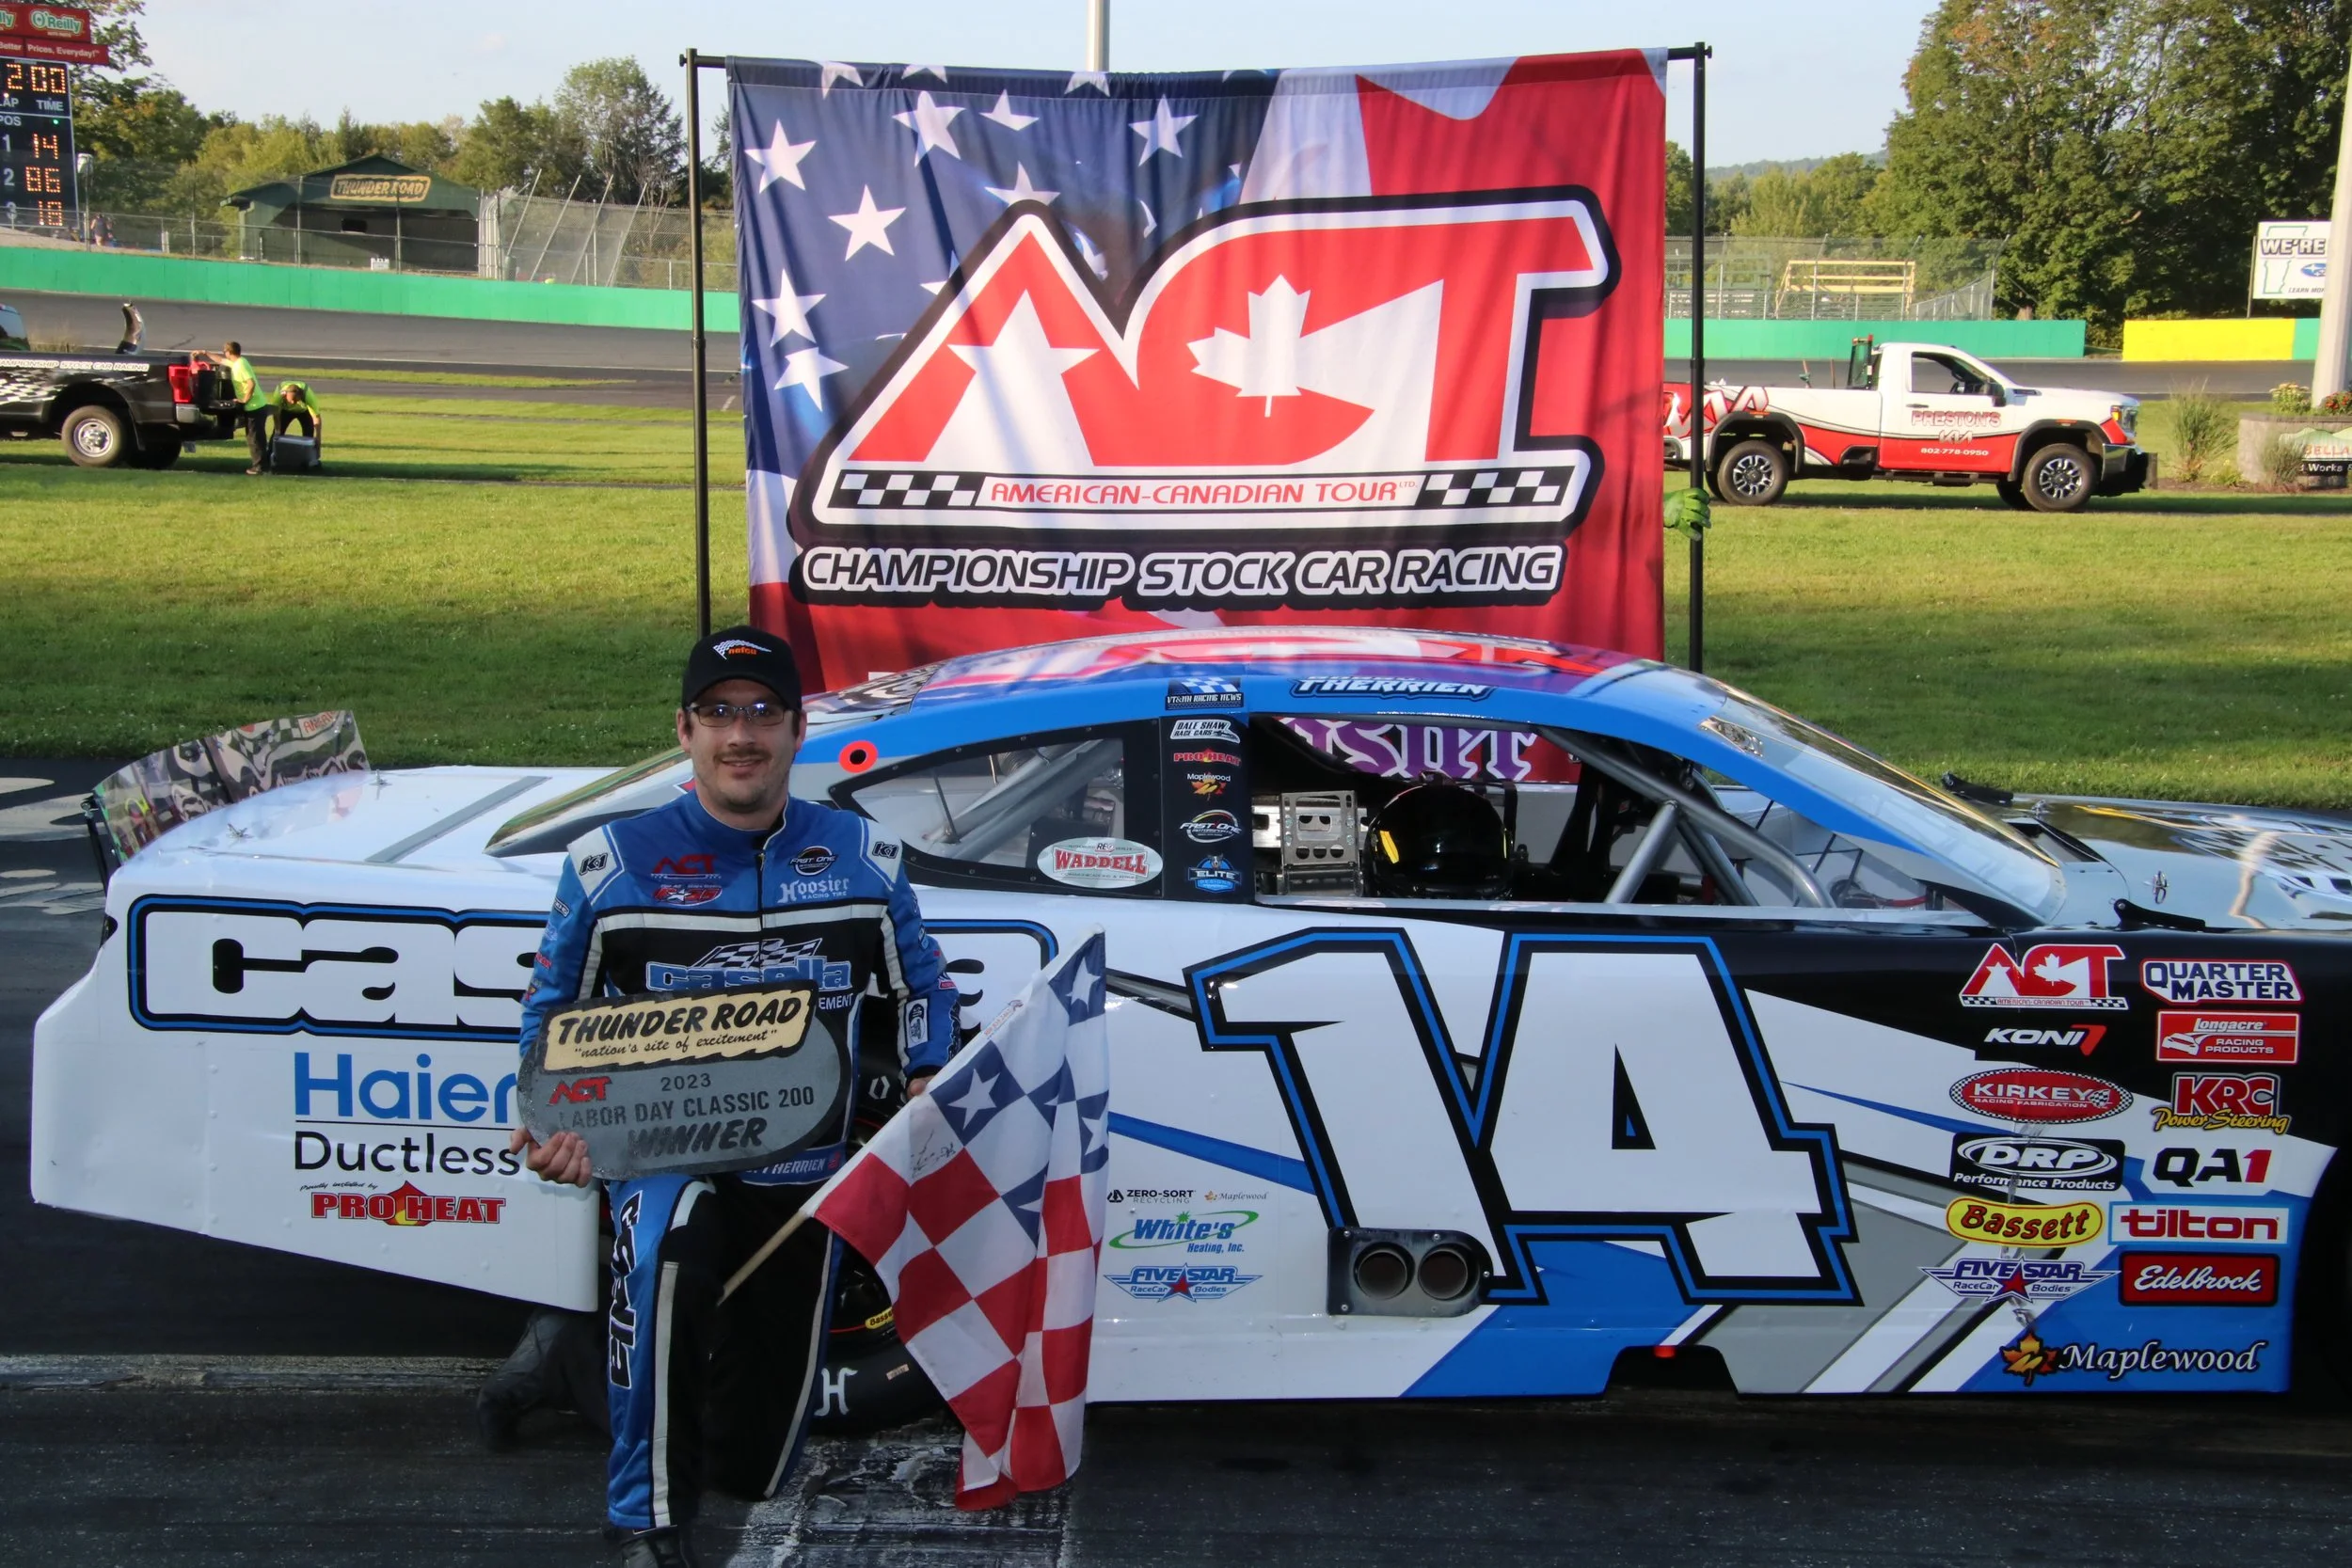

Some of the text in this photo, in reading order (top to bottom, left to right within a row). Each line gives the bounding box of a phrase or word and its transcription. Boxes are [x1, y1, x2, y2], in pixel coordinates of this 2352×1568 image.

[31, 10, 81, 34] O'Reilly
[36, 100, 64, 111] TIME
[3, 133, 58, 159] 1 14
[4, 166, 60, 193] 2 86
[338, 180, 424, 195] THUNDER ROAD
[39, 200, 63, 226] 18
[2261, 238, 2326, 255] WE'RE
[840, 205, 1607, 468] ACT
[114, 363, 149, 372] RACING
[1912, 410, 2001, 427] PRESTON'S
[2309, 464, 2343, 472] Works
[991, 483, 1303, 505] AMERICAN-CANADIAN
[1315, 482, 1397, 503] TOUR
[807, 550, 1558, 590] CHAMPIONSHIP STOCK CAR RACING
[1193, 694, 1218, 703] RACING
[1220, 693, 1242, 702] NEWS
[1296, 677, 1490, 695] THERRIEN
[1177, 721, 1227, 730] DALE SHAW
[1186, 772, 1231, 782] Maplewood
[653, 853, 718, 874] ACT
[1055, 848, 1147, 875] WADDELL
[1196, 870, 1234, 879] ELITE
[777, 874, 850, 904] Hoosier
[1961, 942, 2126, 998] ACT
[2145, 962, 2287, 989] QUARTER
[2171, 980, 2295, 1000] MASTER
[558, 997, 803, 1045] THUNDER ROAD
[2193, 1018, 2264, 1032] Longacre
[644, 1038, 670, 1052] site
[675, 1036, 690, 1053] of
[294, 1052, 516, 1123] Haier
[548, 1073, 712, 1106] ACT 2023
[1974, 1083, 2095, 1101] KIRKEY
[2176, 1076, 2276, 1117] KRC
[635, 1100, 674, 1122] DAY
[683, 1091, 770, 1117] CLASSIC
[779, 1086, 815, 1108] 200
[1185, 929, 1863, 1307] 14
[2153, 1107, 2289, 1134] Power Steering
[628, 1117, 768, 1158] WINNER
[294, 1131, 520, 1176] Ductless
[1979, 1144, 2099, 1169] DRP
[2153, 1148, 2272, 1187] QA1
[1126, 1189, 1268, 1201] ZERO-SORT Maplewood
[2051, 1178, 2116, 1190] Products
[311, 1192, 507, 1223] PRO HEAT
[1133, 1218, 1235, 1240] White's
[1961, 1204, 2090, 1240] Bassett
[2121, 1209, 2279, 1240] tilton
[1187, 1243, 1245, 1254] Heating, Inc.
[1131, 1268, 1235, 1283] FIVE STAR
[1955, 1260, 2083, 1279] FIVE STAR
[2134, 1265, 2262, 1291] Edelbrock
[1131, 1285, 1227, 1294] RaceCar Bodies
[1953, 1281, 2072, 1292] RaceCar Bodies
[2058, 1341, 2269, 1380] Maplewood
